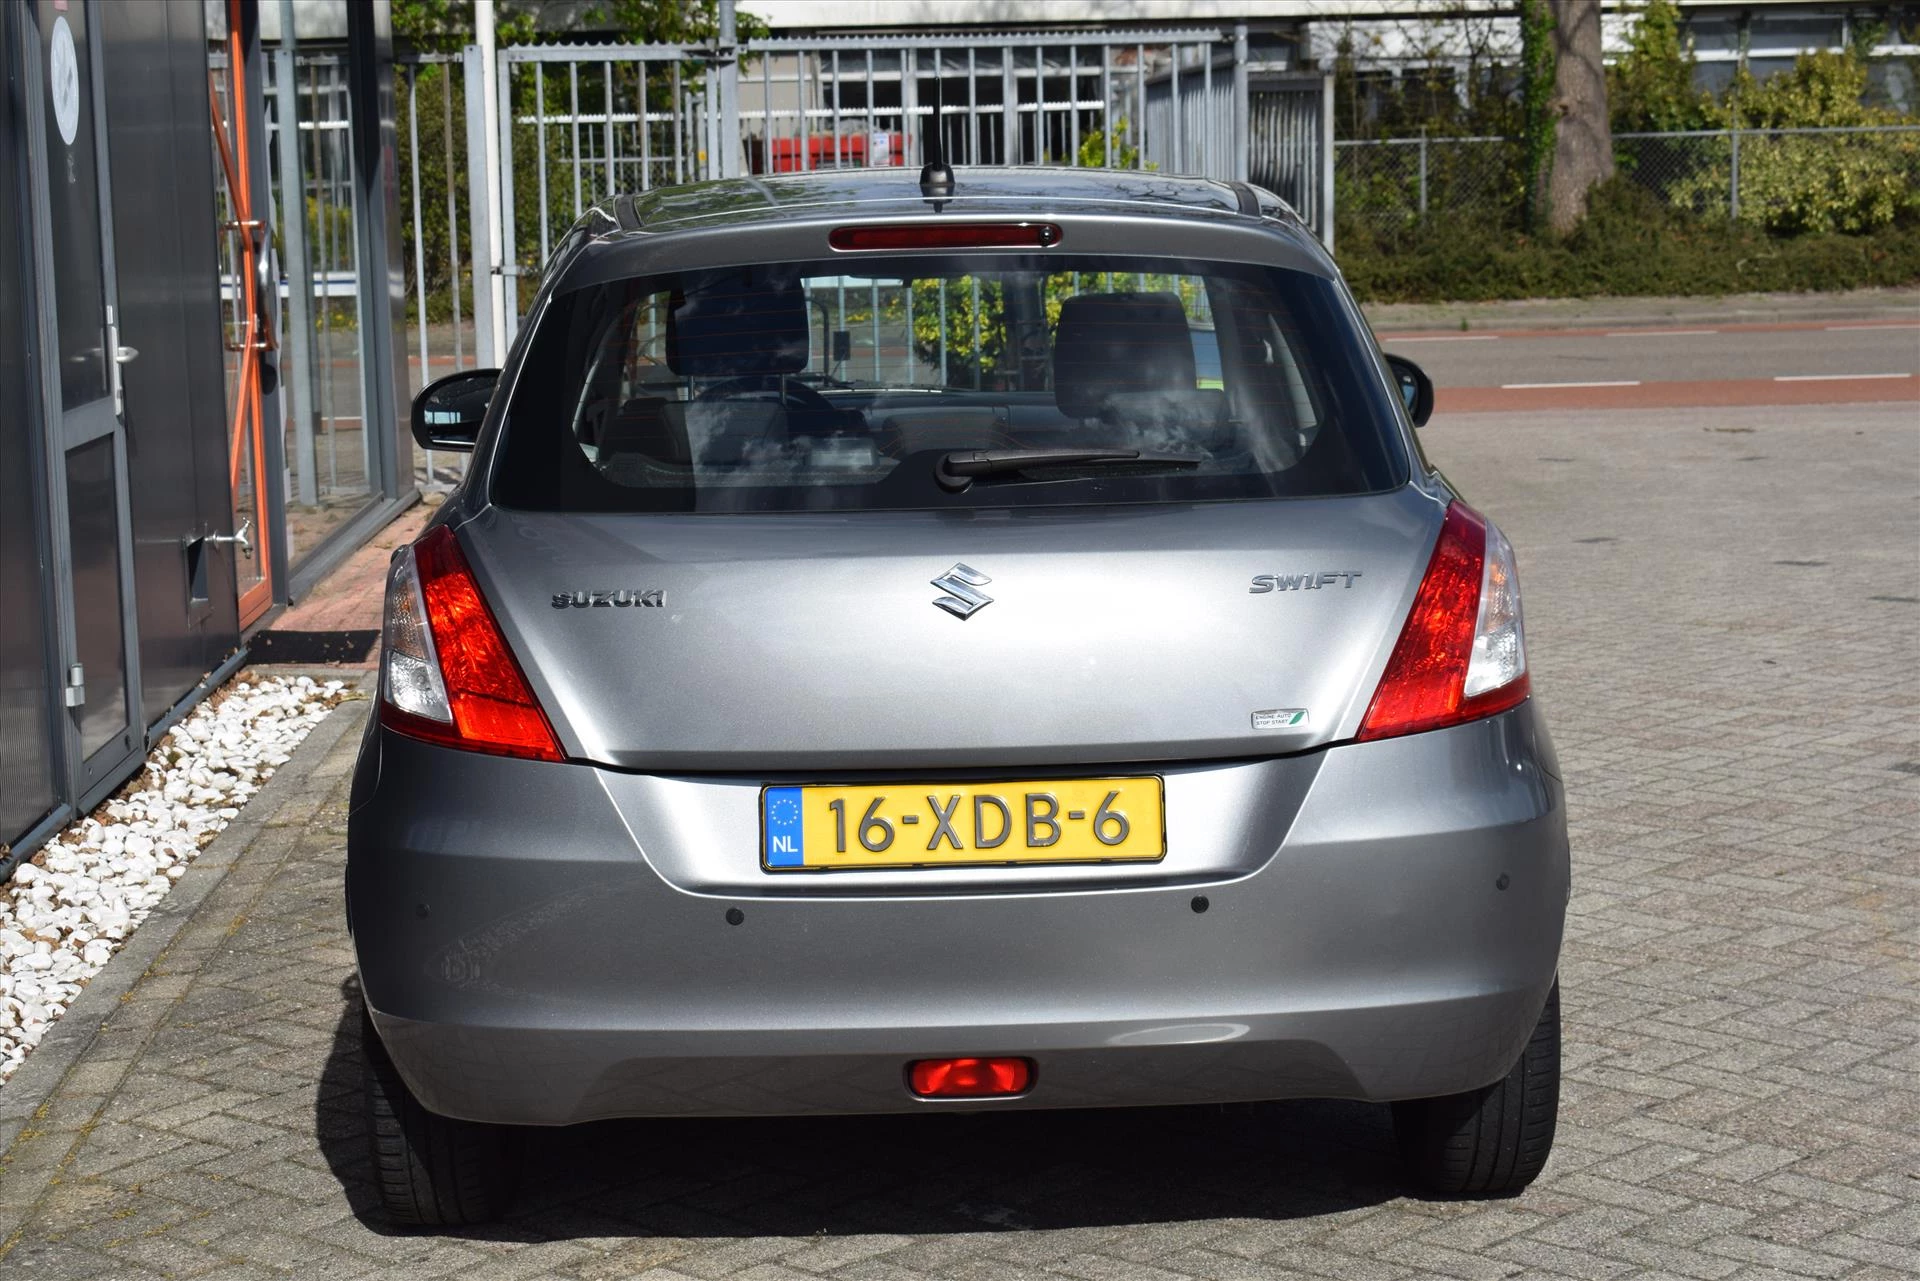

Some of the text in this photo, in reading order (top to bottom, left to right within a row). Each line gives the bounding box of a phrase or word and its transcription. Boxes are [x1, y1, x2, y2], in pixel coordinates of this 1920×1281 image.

[1249, 571, 1362, 594] SWIFT
[551, 590, 667, 609] SUZUKI
[829, 791, 1130, 853] 16-XDB-6
[772, 836, 798, 853] NL
